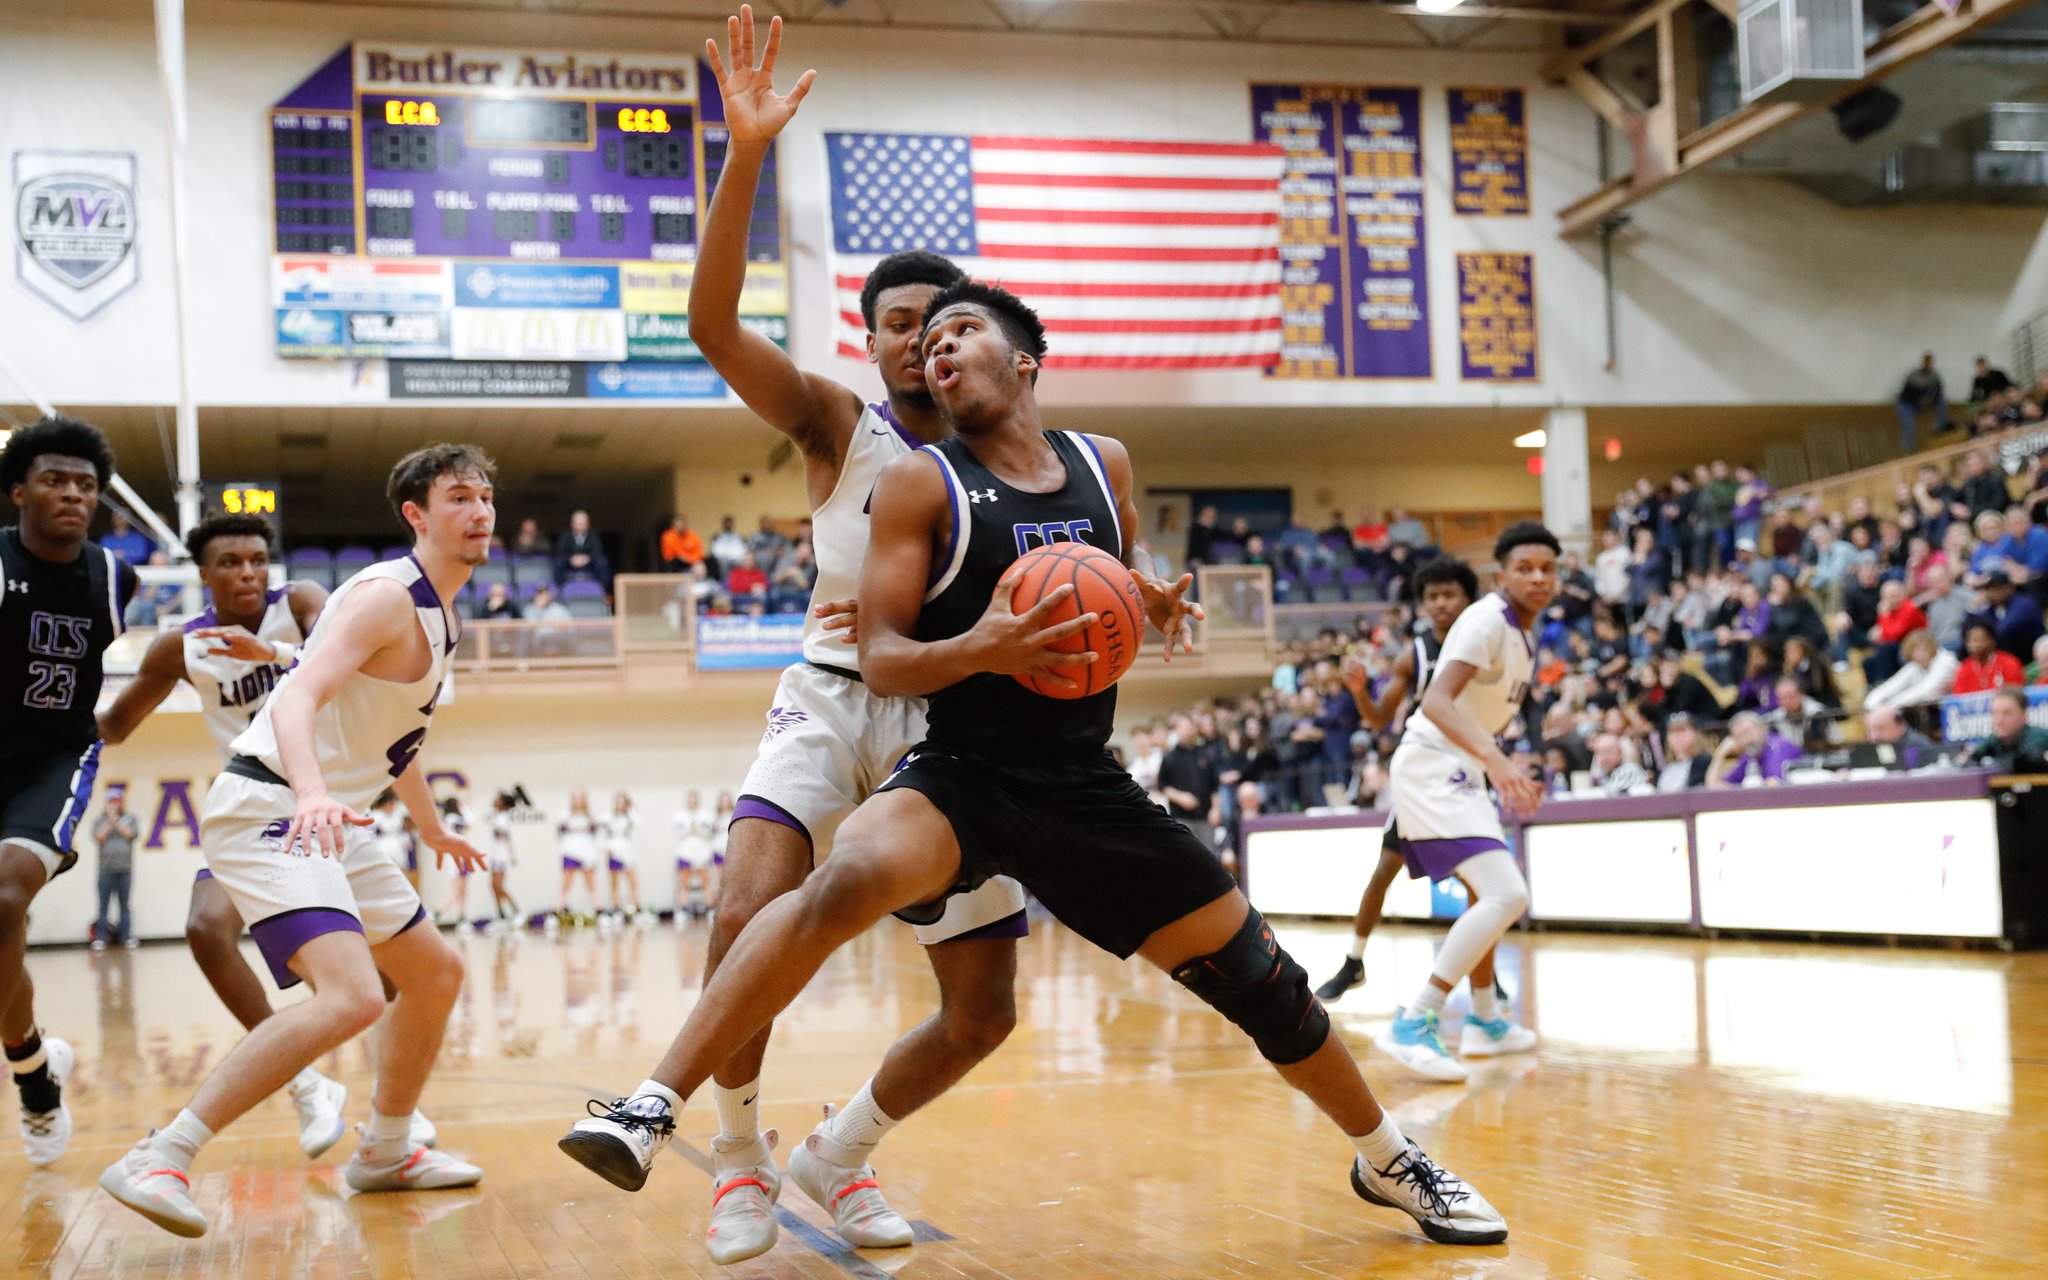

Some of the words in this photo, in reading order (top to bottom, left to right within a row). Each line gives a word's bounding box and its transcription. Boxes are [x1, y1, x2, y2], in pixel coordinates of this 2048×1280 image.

[366, 51, 501, 85] Butler
[513, 55, 688, 91] Aviators
[28, 610, 92, 659] CCS
[23, 660, 77, 710] 23
